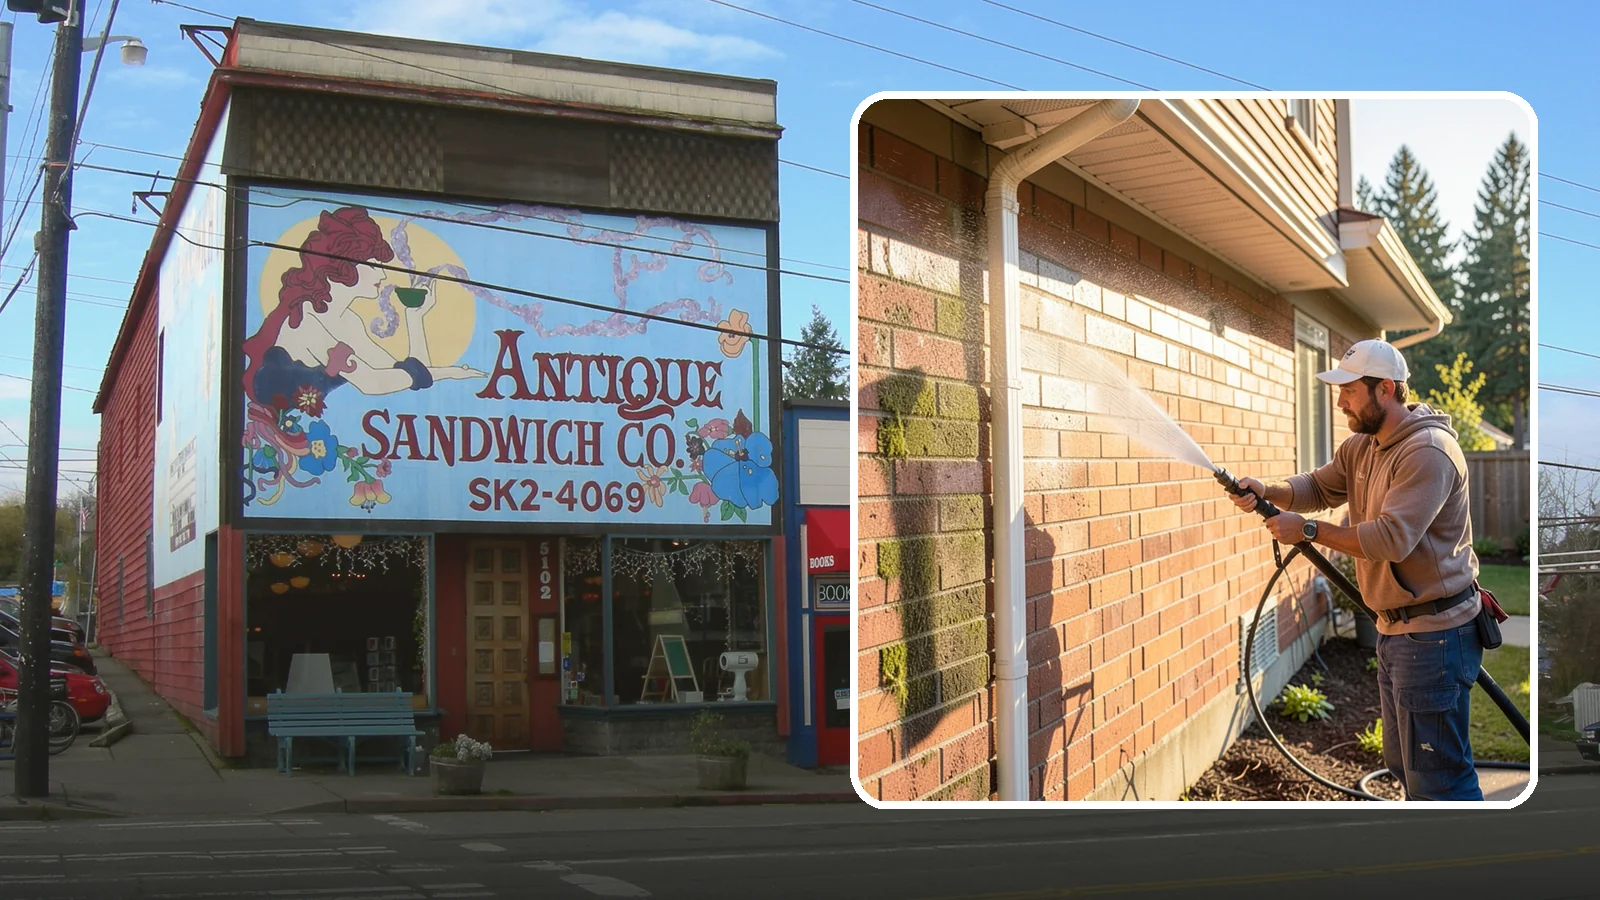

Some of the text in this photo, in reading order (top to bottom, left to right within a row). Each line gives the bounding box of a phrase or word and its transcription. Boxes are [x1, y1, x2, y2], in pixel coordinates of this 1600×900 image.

[476, 329, 723, 420] ANTIQUE
[361, 409, 686, 468] SANDWICH CO.
[469, 477, 645, 512] SK2-4069
[540, 541, 551, 600] 5102
[810, 555, 834, 569] BOOKS
